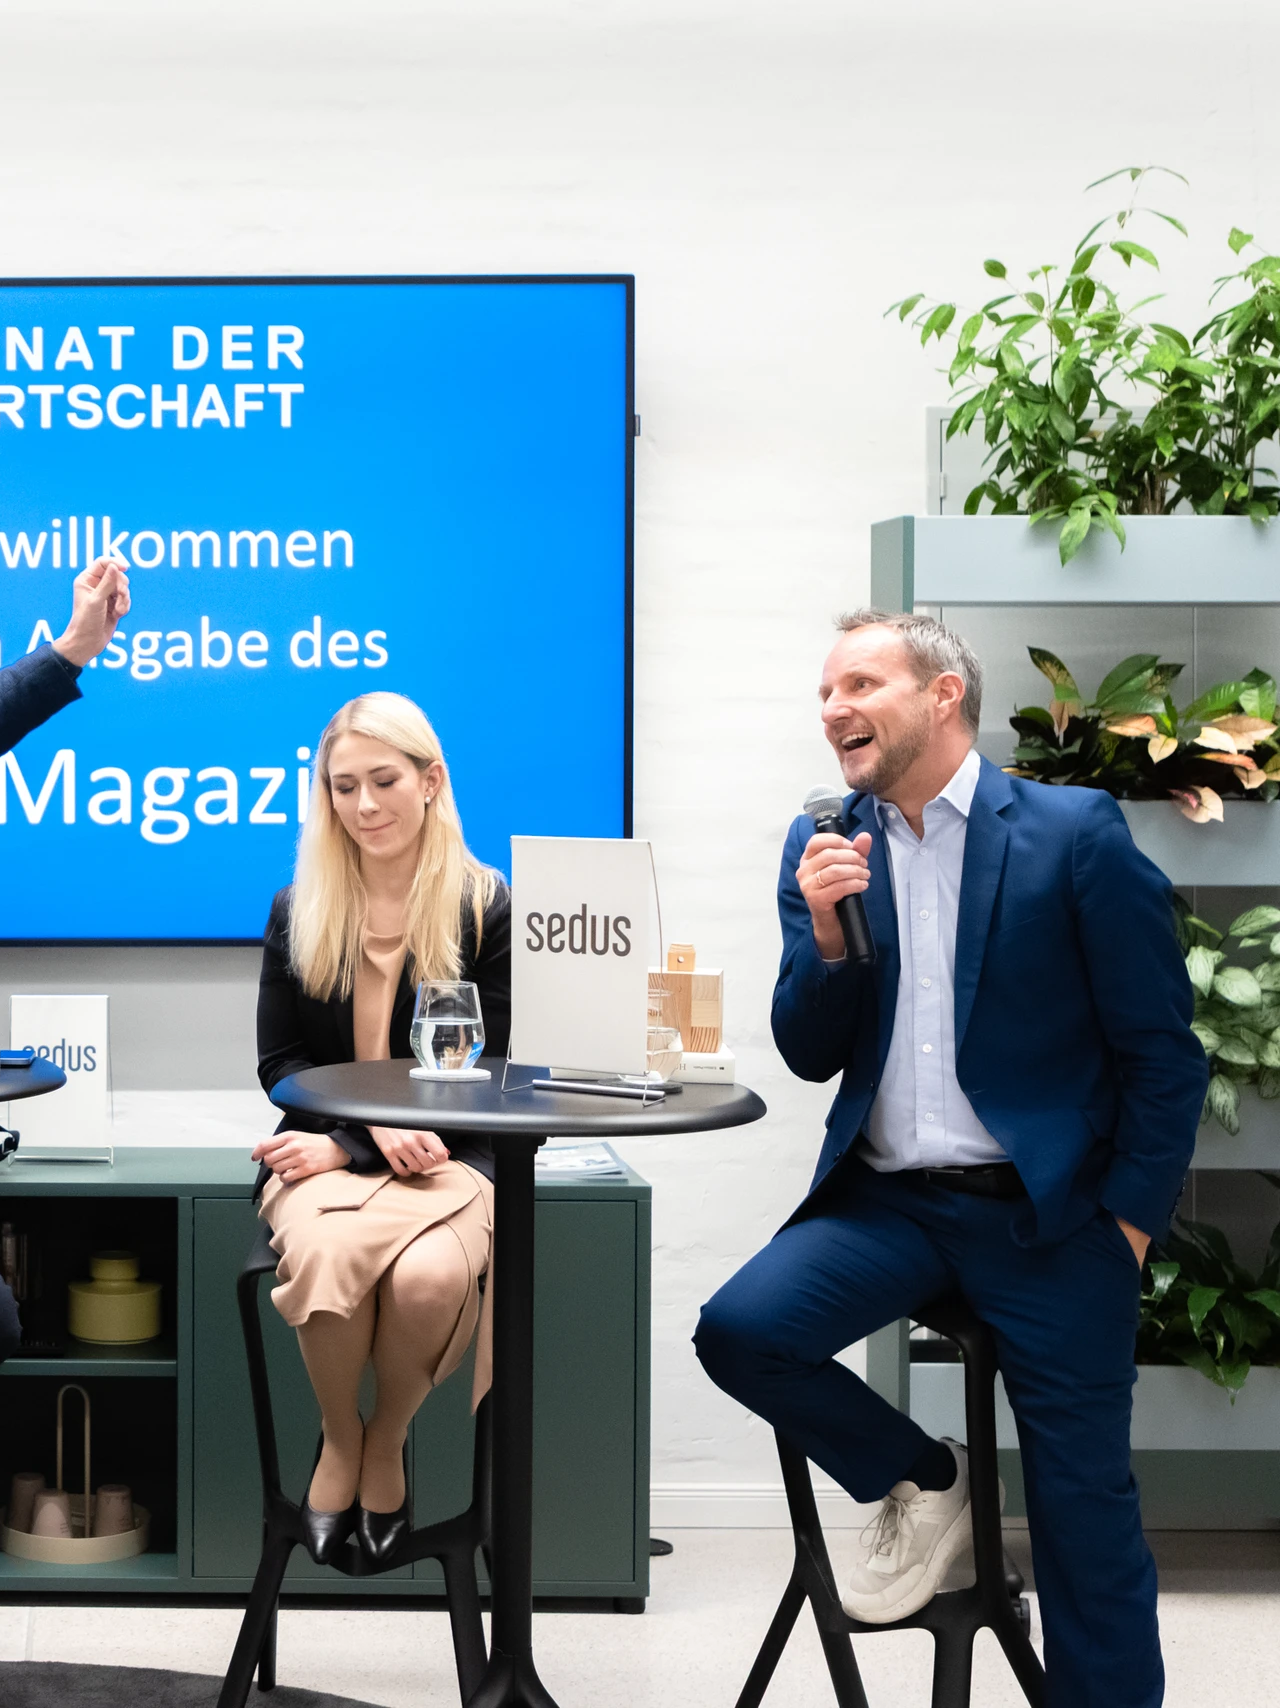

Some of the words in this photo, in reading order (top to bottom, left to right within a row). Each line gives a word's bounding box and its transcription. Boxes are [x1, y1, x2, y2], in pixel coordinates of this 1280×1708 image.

[172, 325, 305, 370] DER
[26, 615, 269, 681] Asgabe
[289, 615, 389, 669] des
[526, 903, 632, 957] sedus
